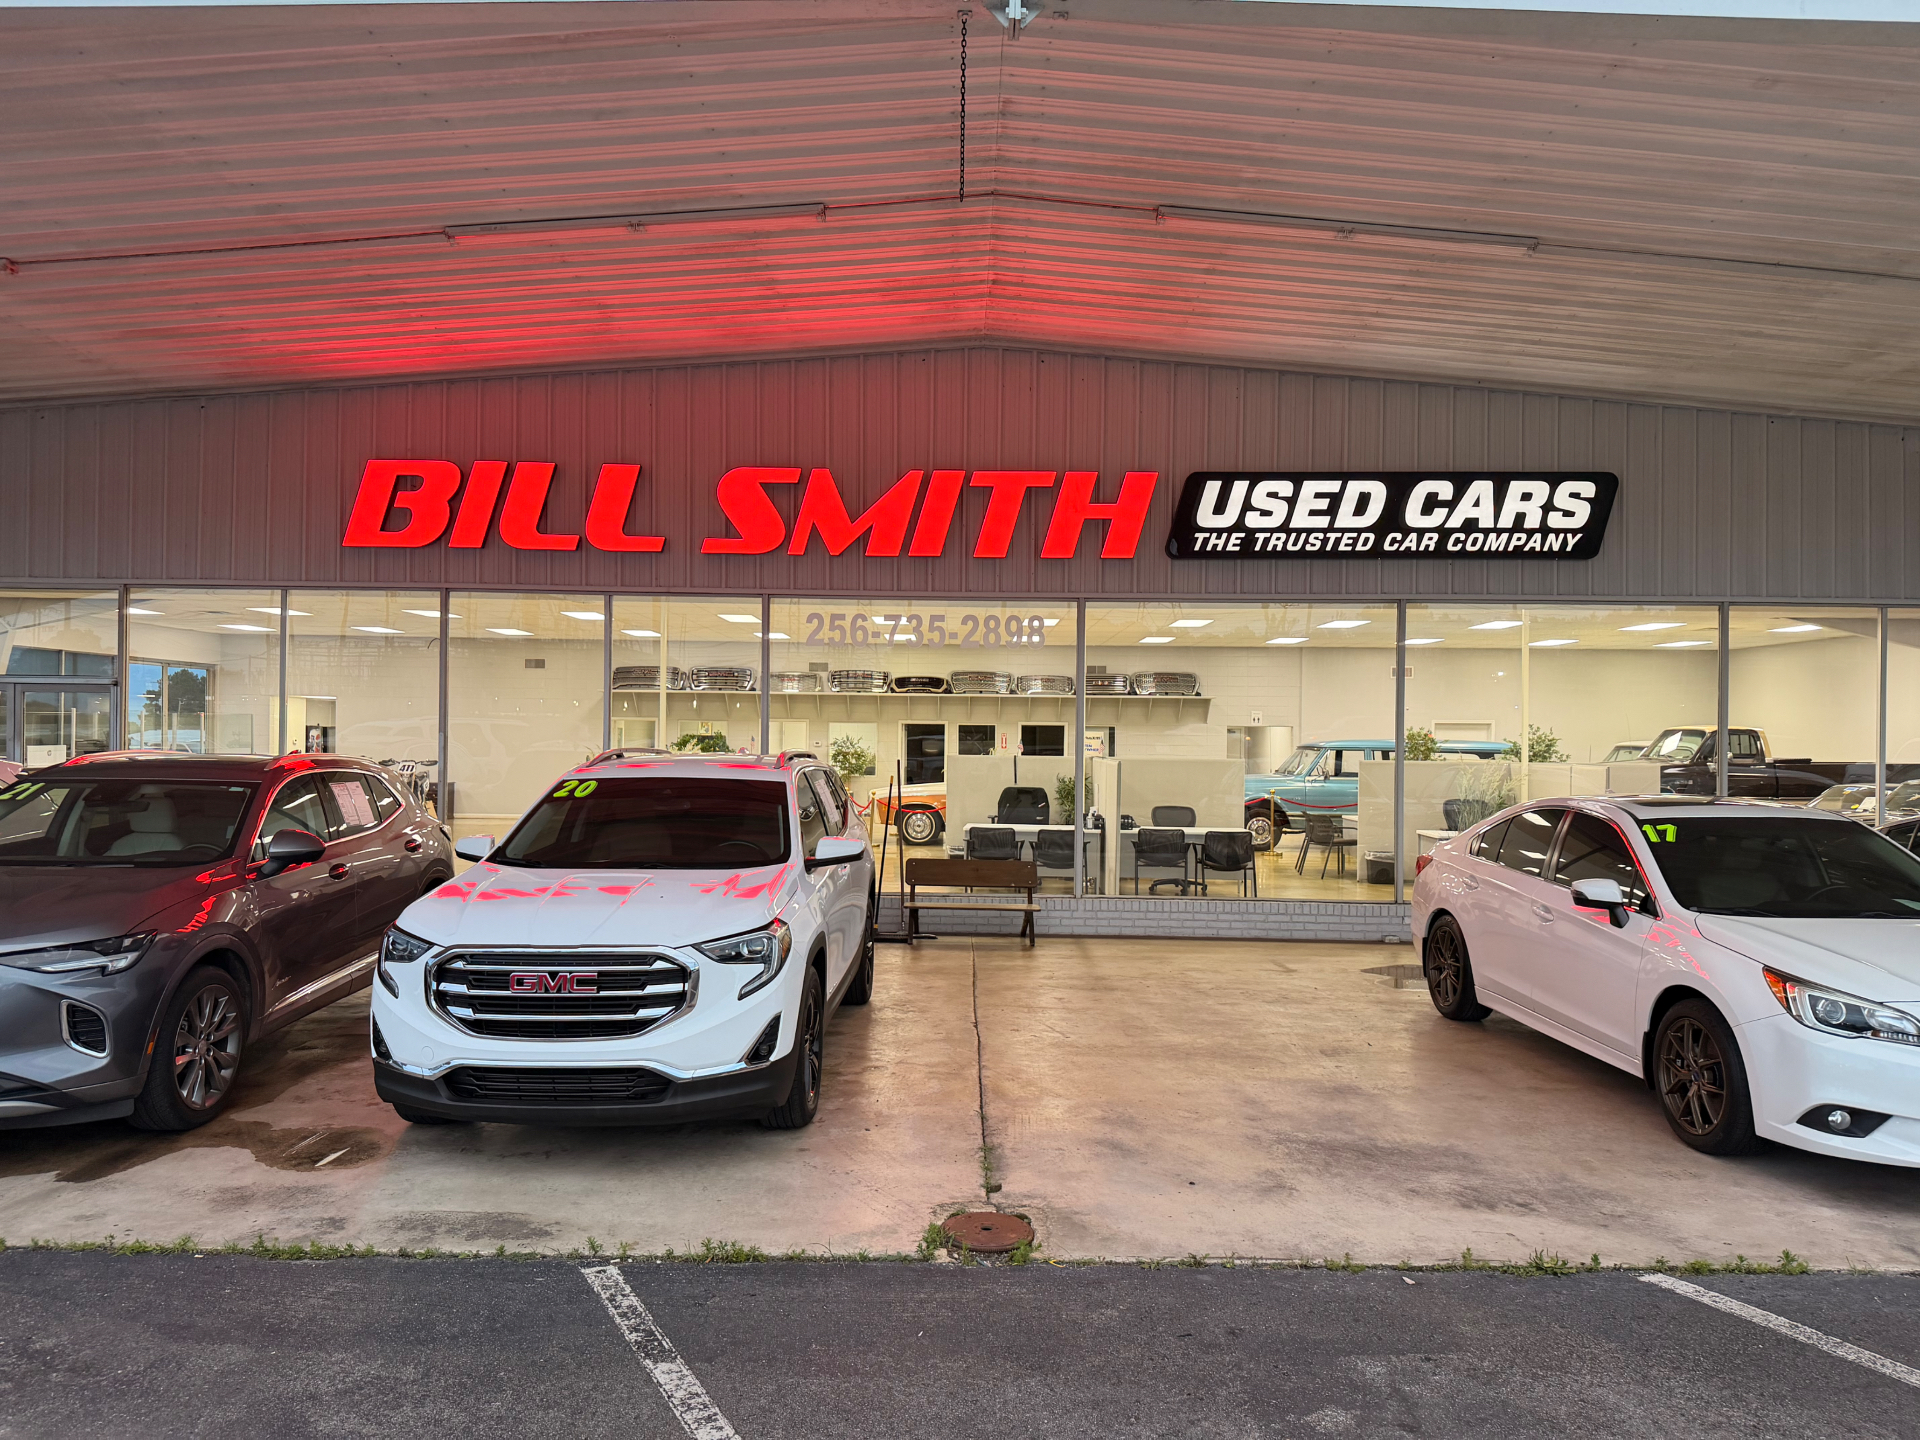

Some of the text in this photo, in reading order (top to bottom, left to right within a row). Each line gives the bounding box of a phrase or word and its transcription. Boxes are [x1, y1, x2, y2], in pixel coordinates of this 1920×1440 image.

[342, 459, 1159, 559] BILL SMITH
[1196, 480, 1597, 528] USED CARS
[1193, 532, 1584, 551] THE TRUSTED CAR COMPANY
[805, 612, 1046, 649] 256-735-2898
[398, 764, 416, 773] 411
[0, 782, 46, 801] 21
[553, 780, 599, 798] 20
[1642, 823, 1678, 843] 17
[509, 972, 598, 993] GMC
